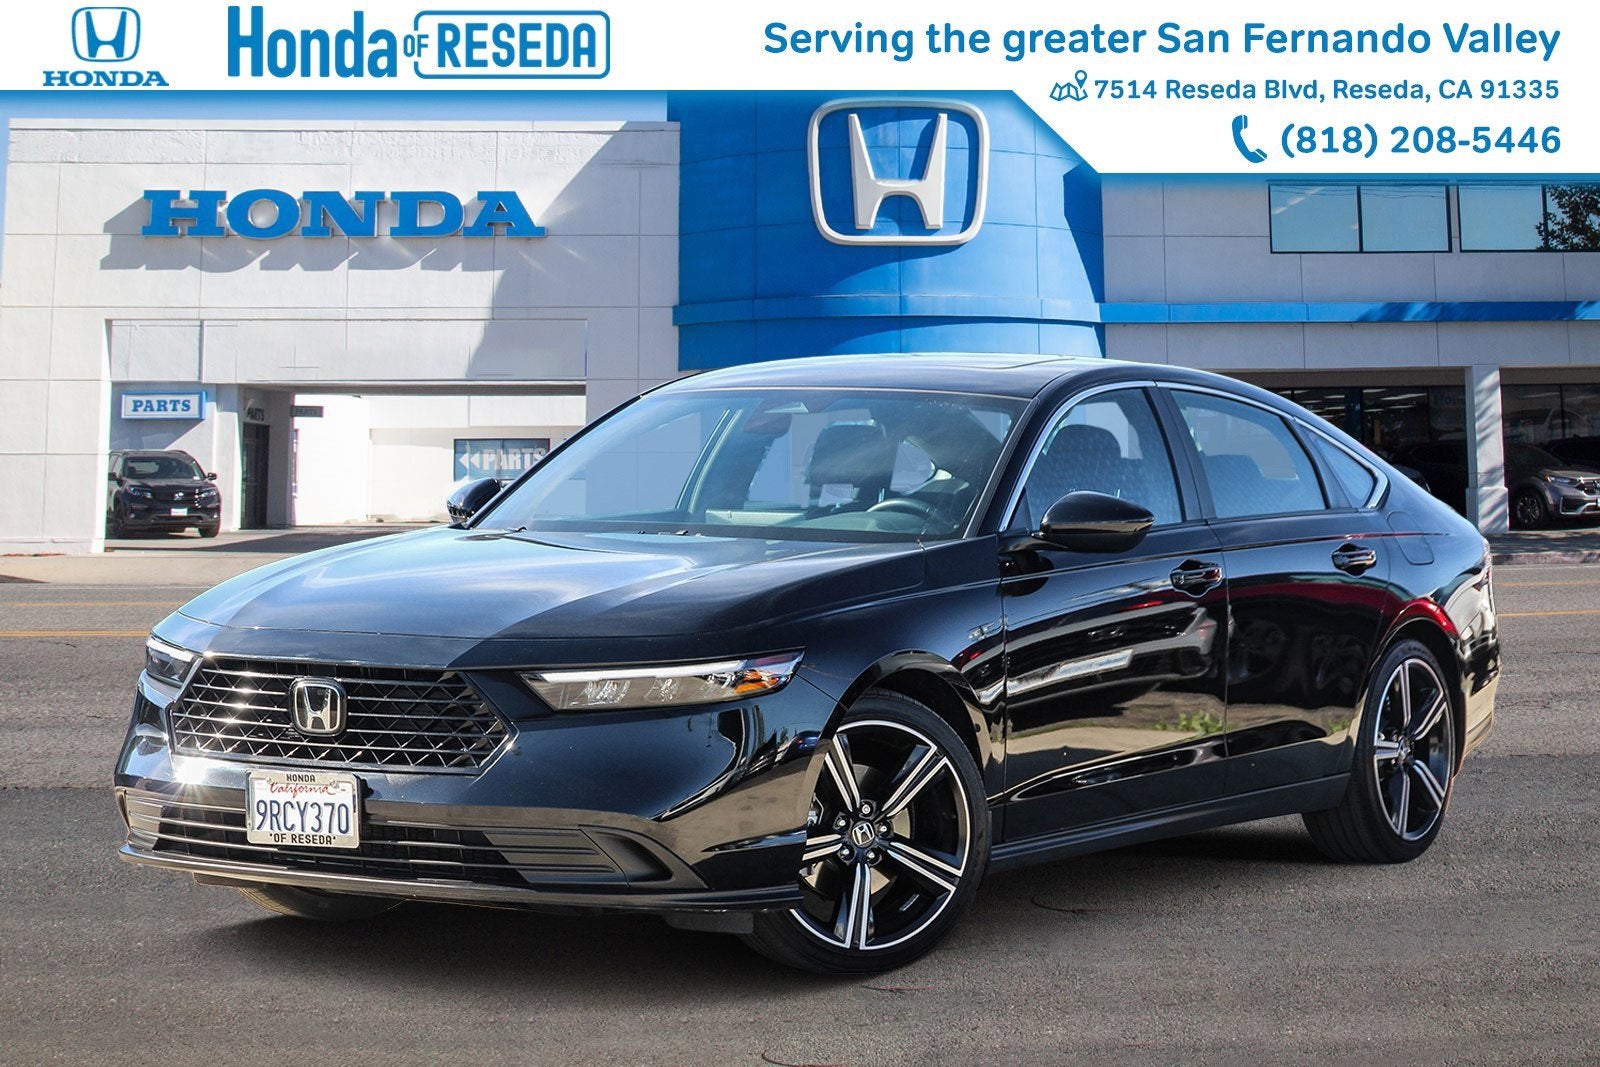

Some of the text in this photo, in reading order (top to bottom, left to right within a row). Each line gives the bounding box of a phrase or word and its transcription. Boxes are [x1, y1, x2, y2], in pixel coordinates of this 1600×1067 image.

[141, 189, 547, 240] HONDA
[132, 399, 191, 412] PARTS
[482, 448, 546, 470] PARTS
[286, 774, 316, 783] HONDA
[270, 781, 336, 798] California
[256, 799, 350, 834] 9RCY370
[292, 833, 333, 845] RESEDA
